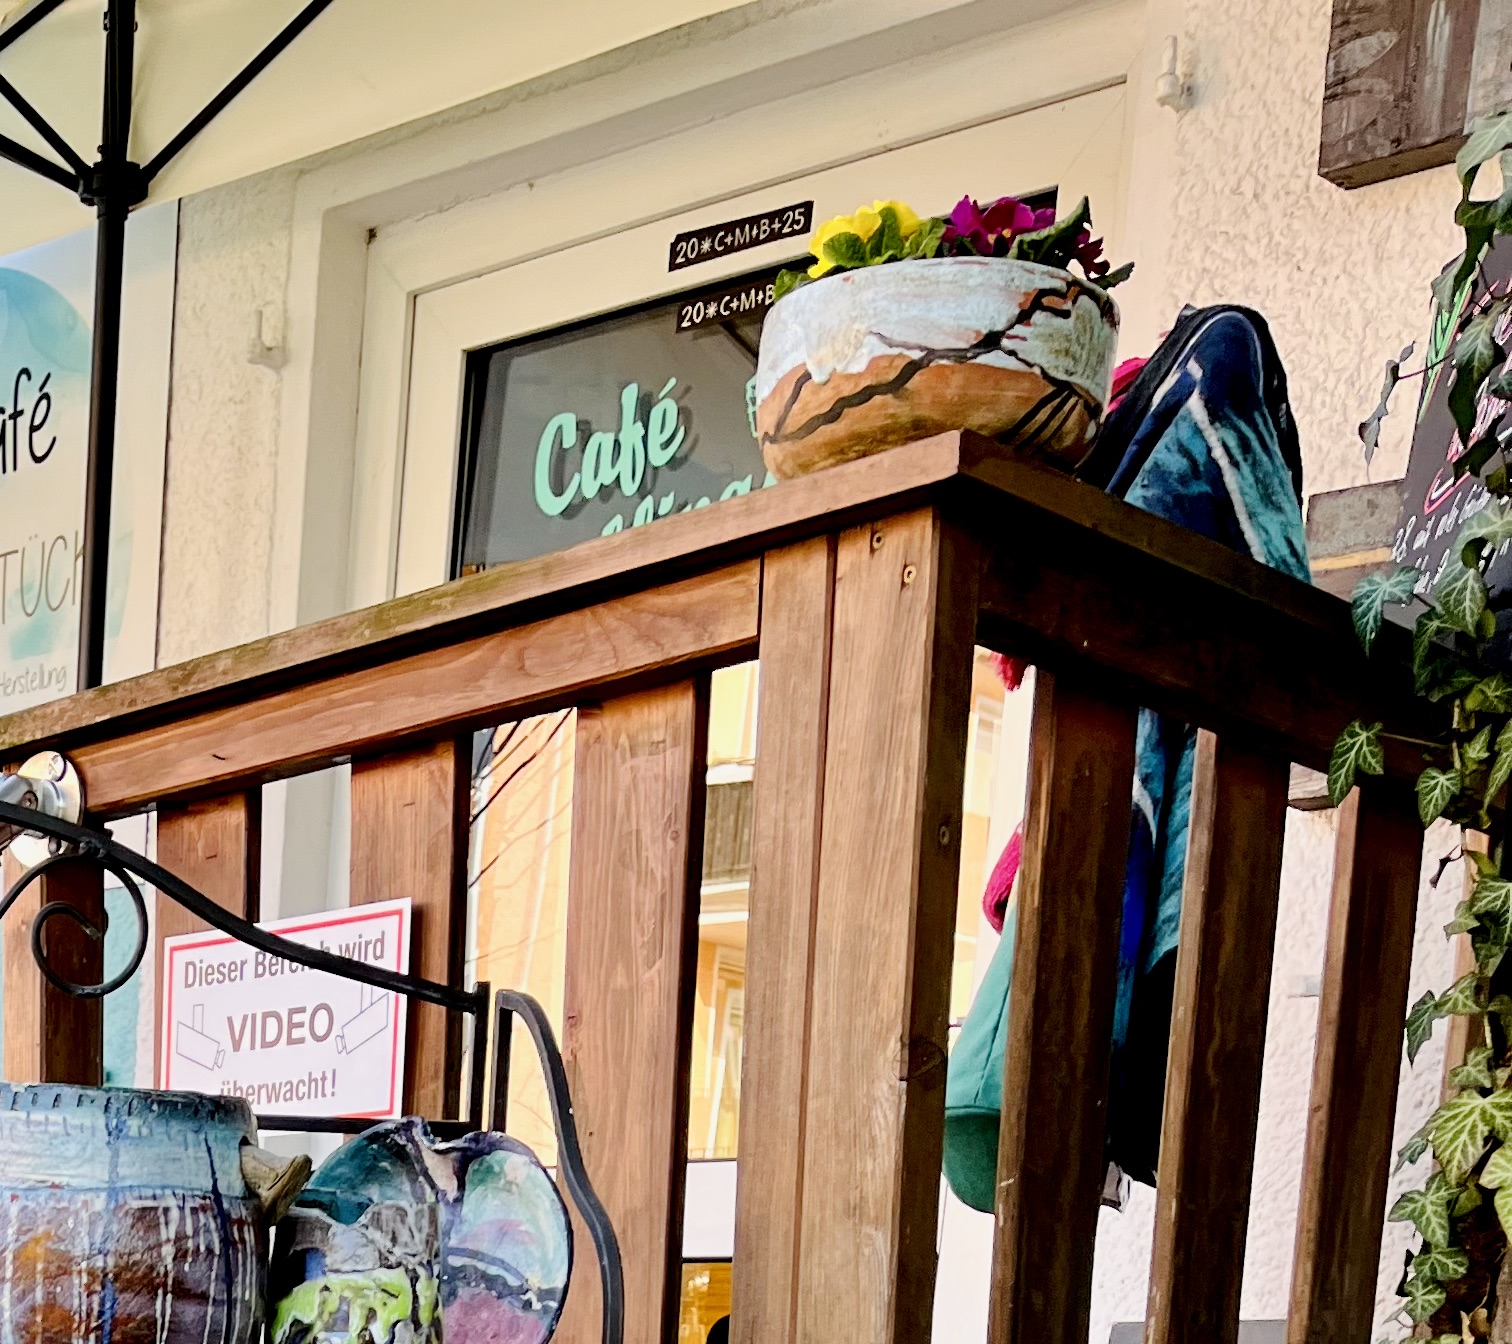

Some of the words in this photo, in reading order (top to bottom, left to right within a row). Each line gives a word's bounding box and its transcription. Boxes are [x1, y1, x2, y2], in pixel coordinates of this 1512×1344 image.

[534, 376, 685, 516] Café
[184, 957, 248, 989] Dieser
[227, 1002, 335, 1053] VIDEO
